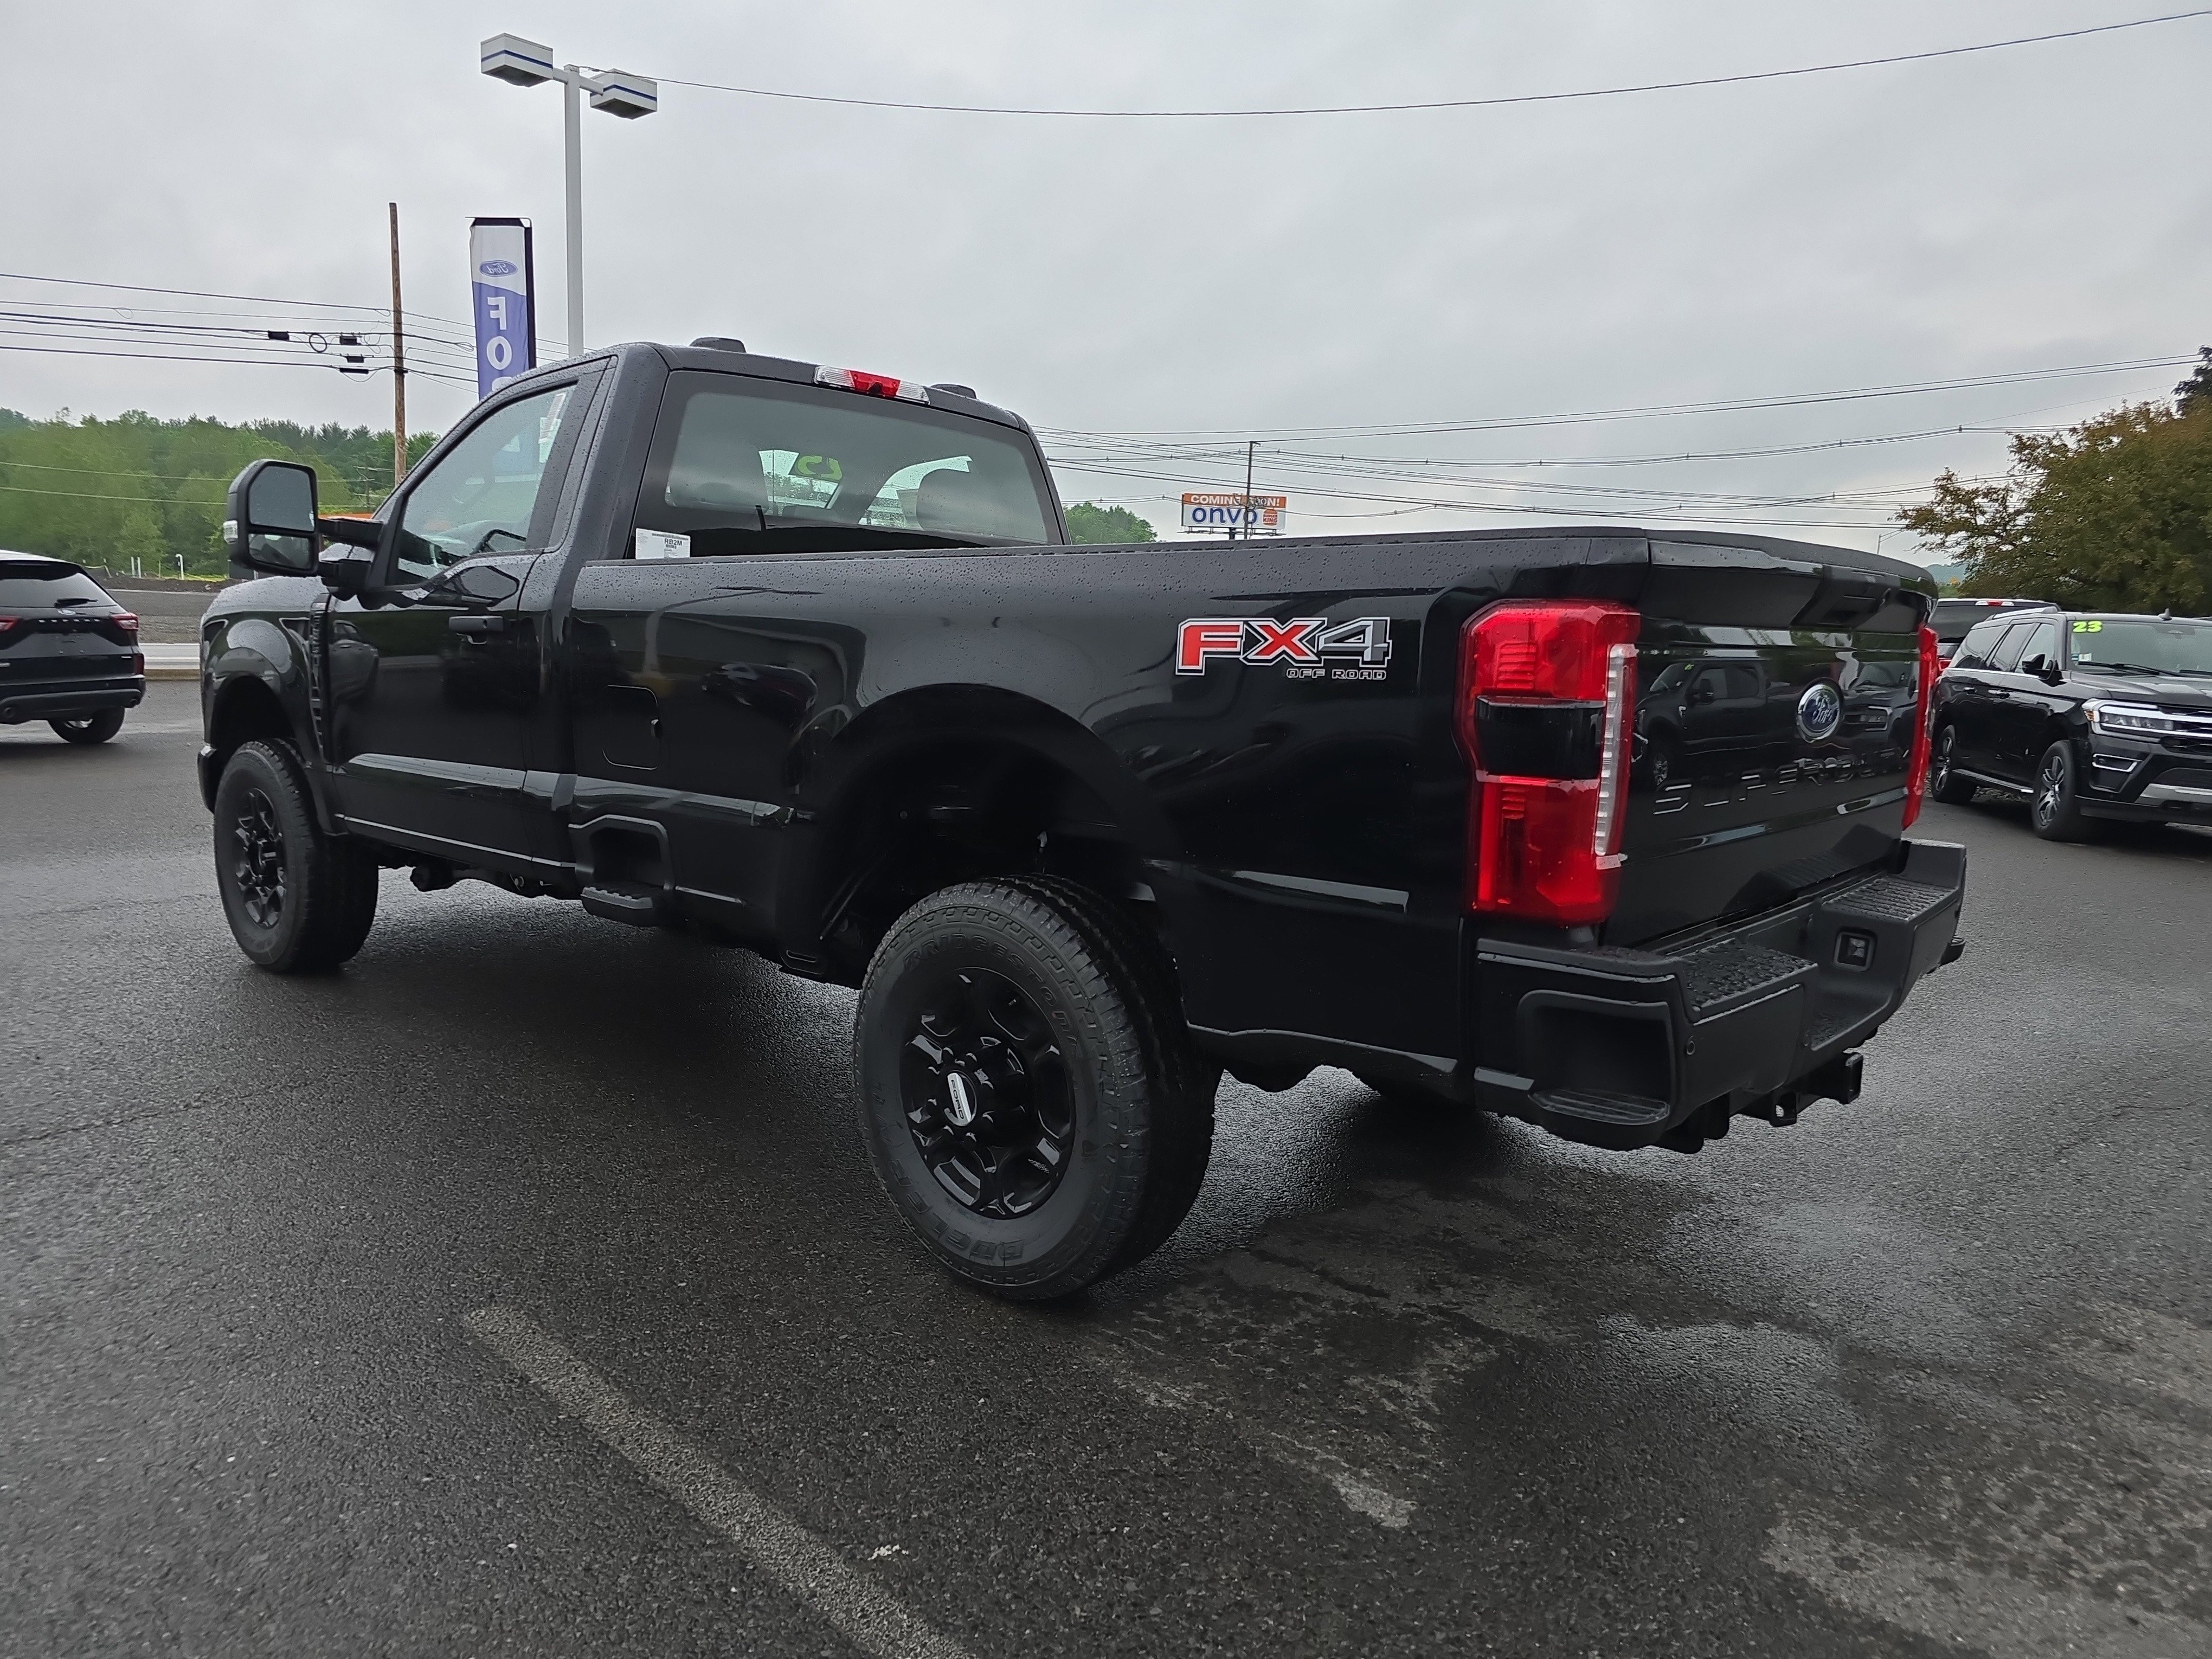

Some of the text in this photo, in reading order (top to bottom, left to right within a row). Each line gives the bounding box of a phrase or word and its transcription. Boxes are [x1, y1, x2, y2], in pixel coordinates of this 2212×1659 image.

[1190, 494, 1241, 505] COMING
[1192, 507, 1257, 524] onvo
[664, 538, 683, 546] RB2M
[2072, 621, 2102, 633] 23
[1175, 617, 1392, 676] FX4
[1287, 668, 1387, 680] OFF ROAD
[951, 1079, 964, 1120] FORD
